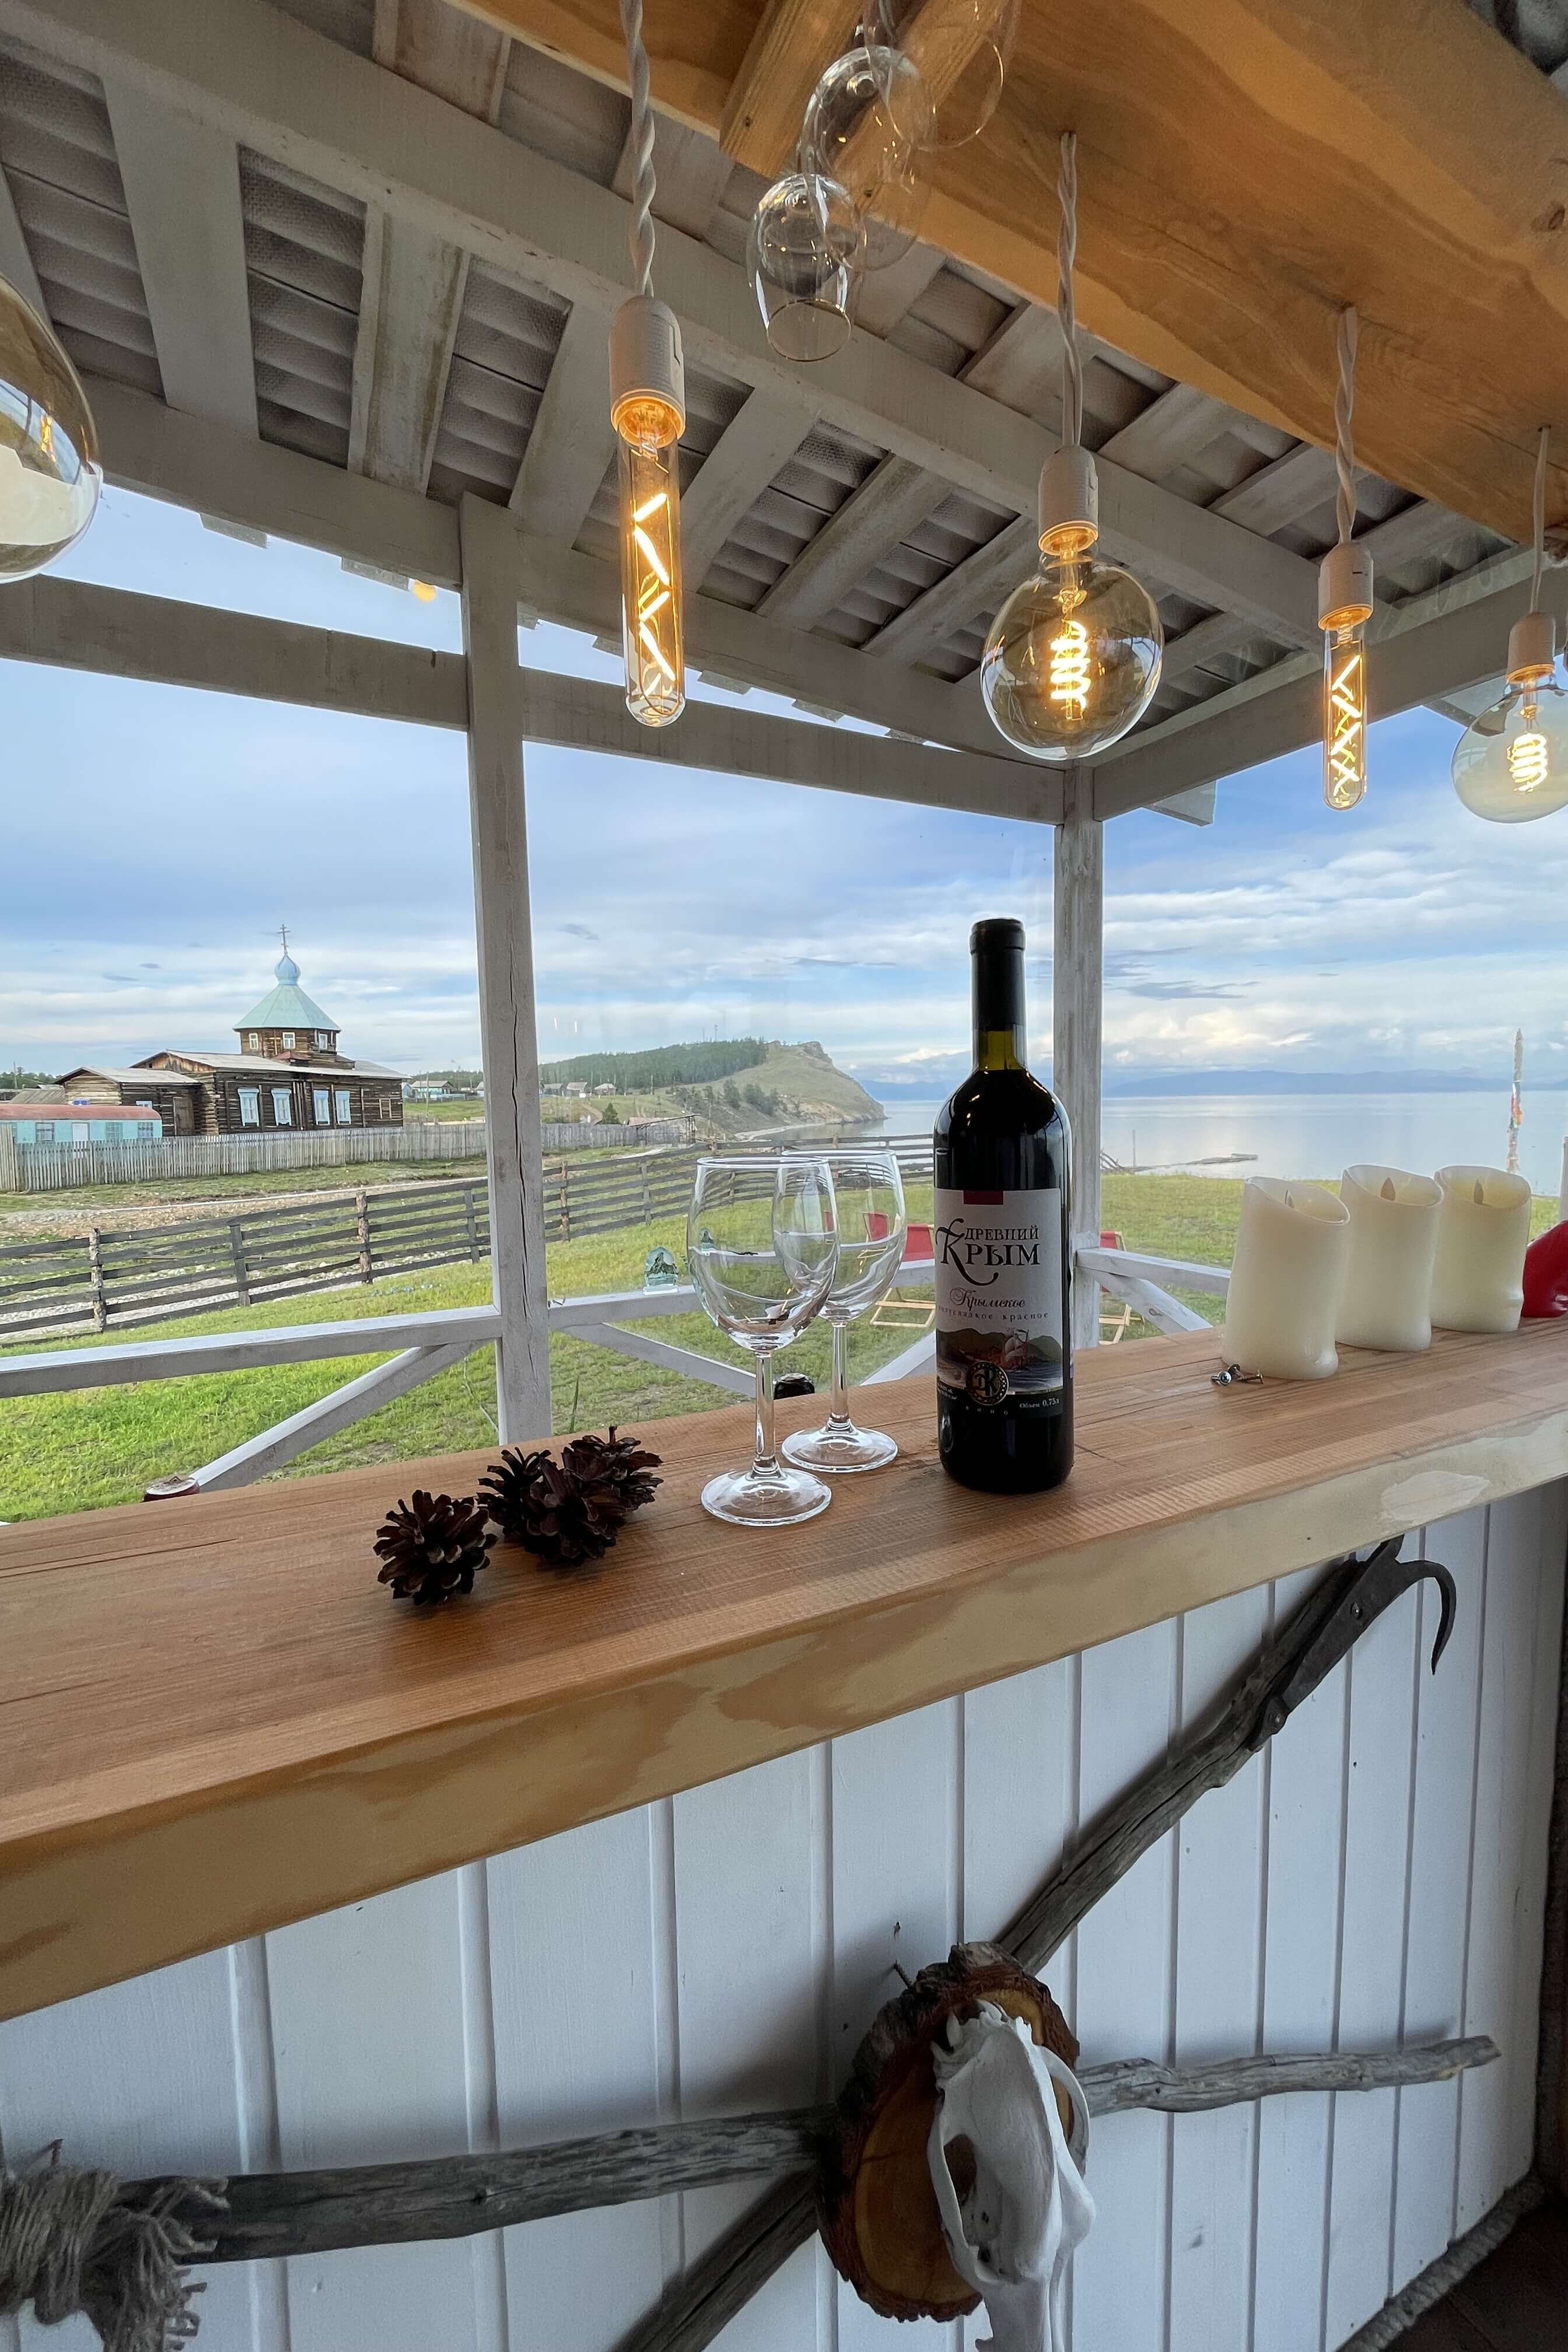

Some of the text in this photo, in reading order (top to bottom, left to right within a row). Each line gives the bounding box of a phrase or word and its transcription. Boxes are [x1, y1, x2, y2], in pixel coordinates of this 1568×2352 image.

[964, 1225, 1039, 1240] ДРЕВНИЙ
[936, 1218, 1040, 1286] КРЫМ
[950, 1287, 1026, 1311] Крымское
[1002, 1312, 1048, 1322] красное
